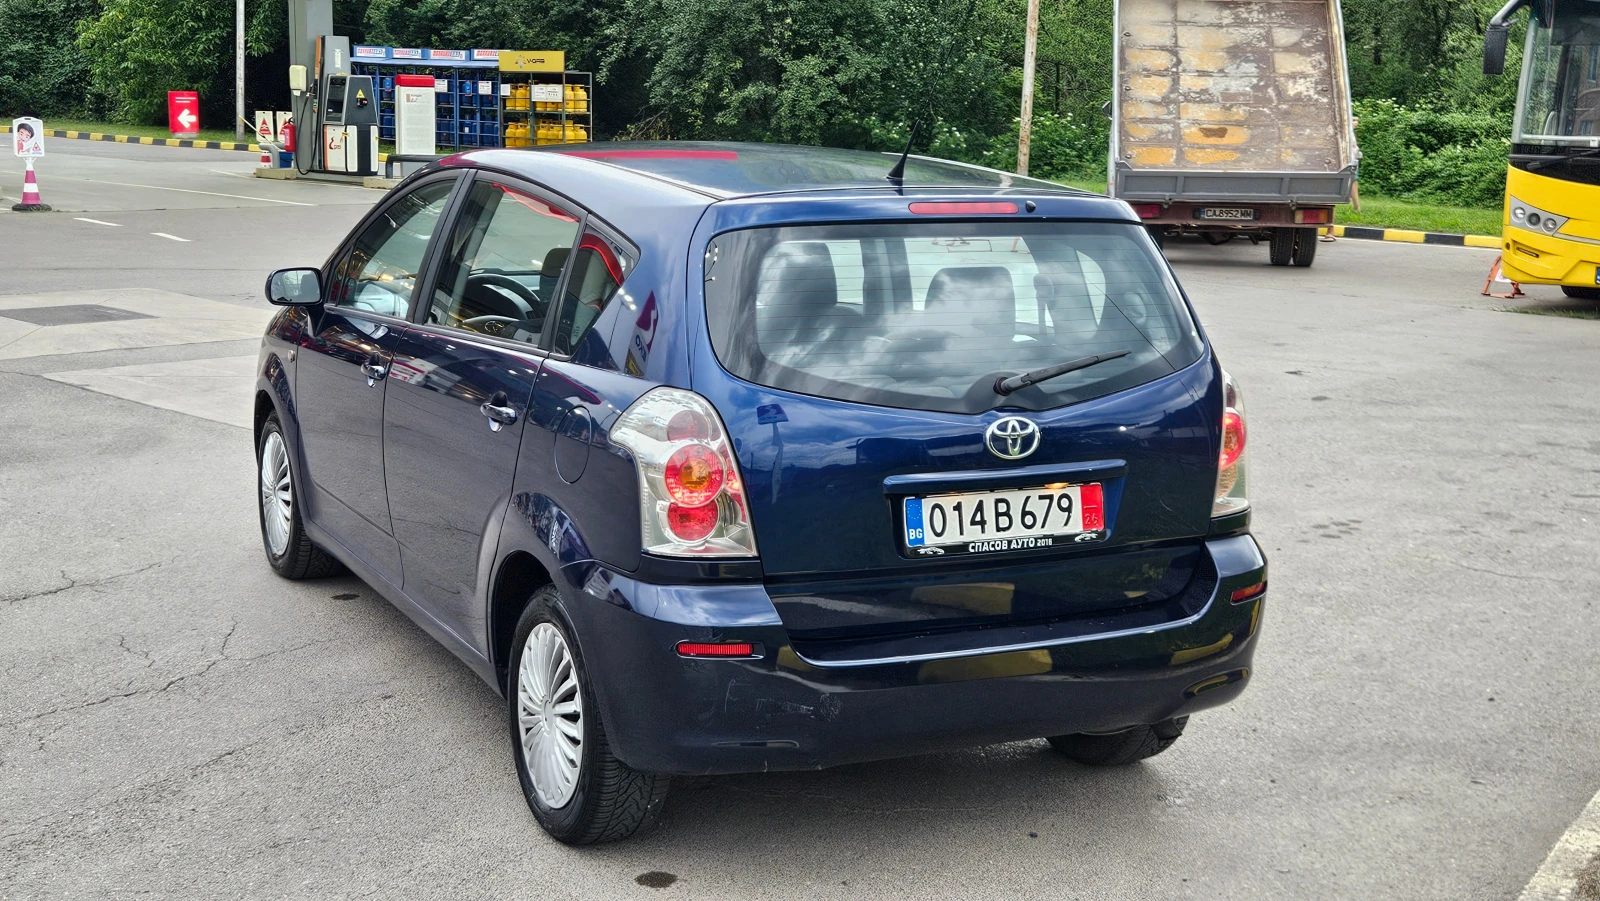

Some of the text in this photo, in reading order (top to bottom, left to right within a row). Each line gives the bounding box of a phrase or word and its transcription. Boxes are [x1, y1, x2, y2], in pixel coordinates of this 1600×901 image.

[909, 528, 923, 540] BG
[968, 539, 1008, 553] СПАСОВ
[1010, 537, 1036, 550] АУТО
